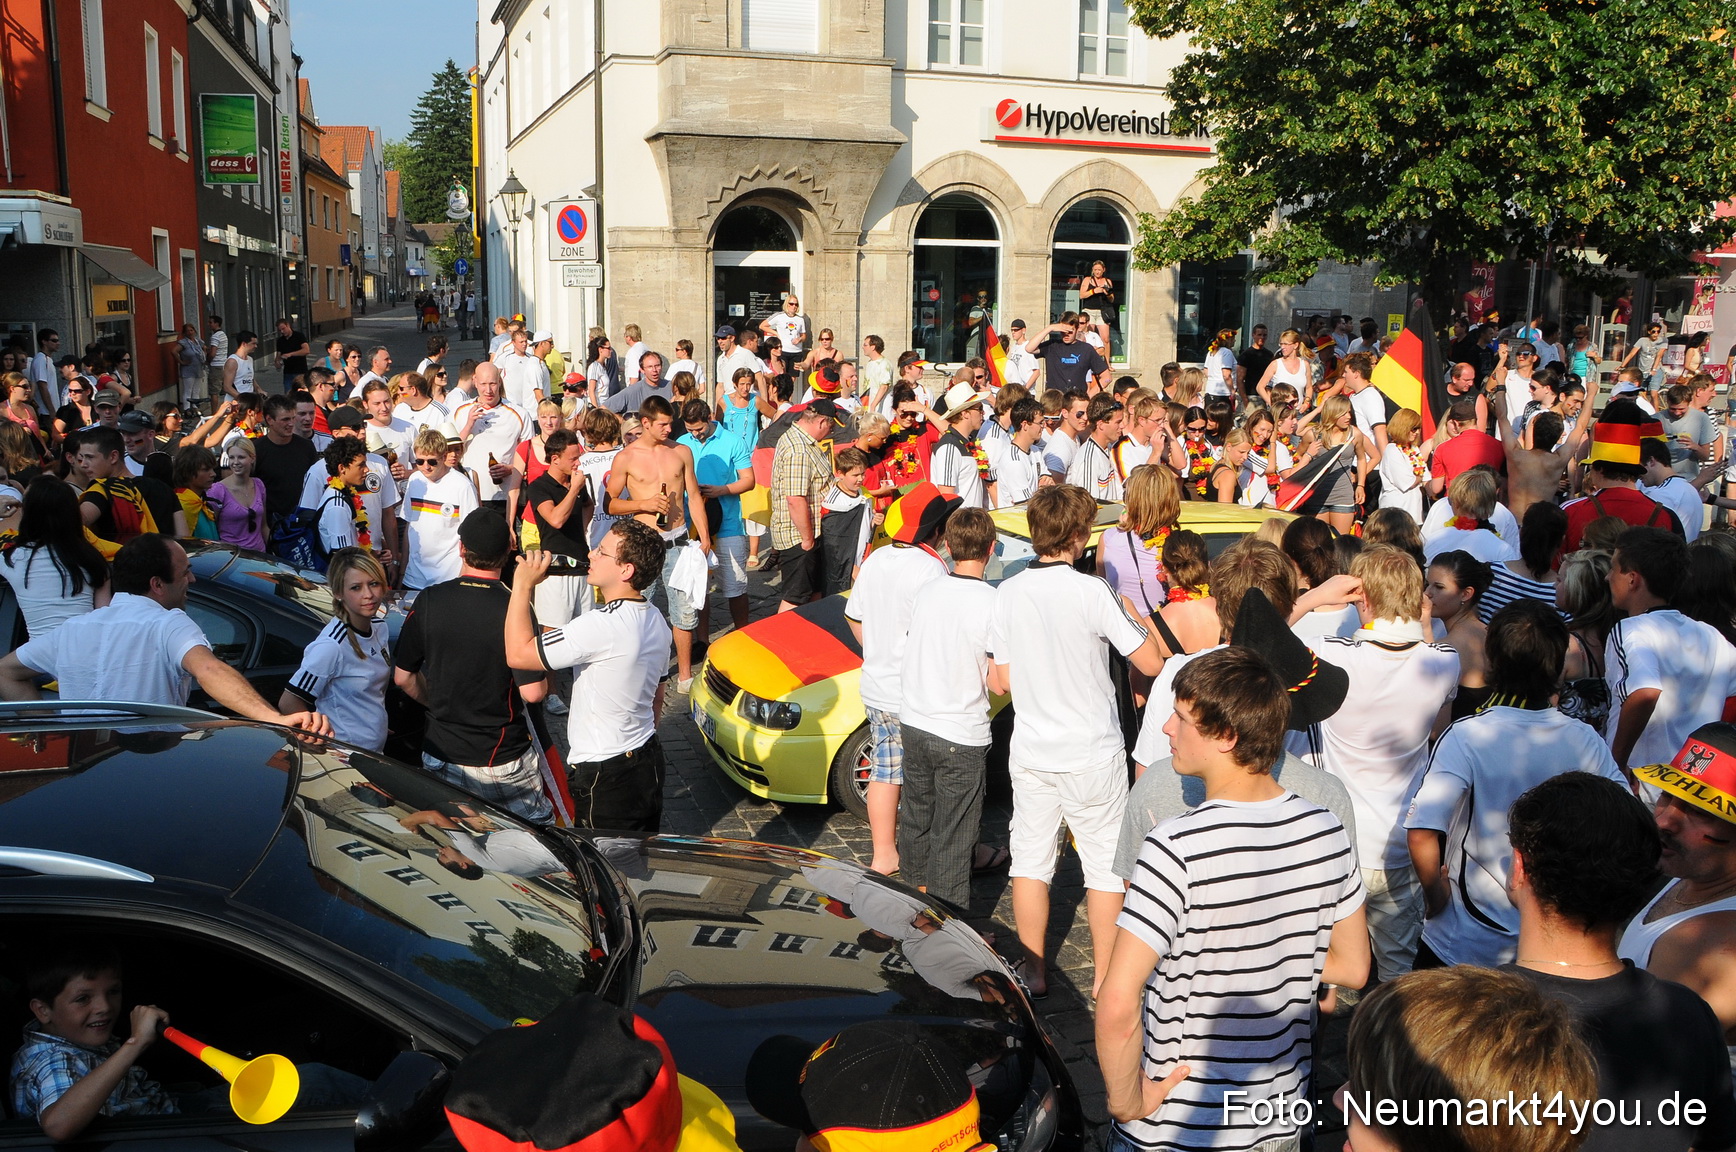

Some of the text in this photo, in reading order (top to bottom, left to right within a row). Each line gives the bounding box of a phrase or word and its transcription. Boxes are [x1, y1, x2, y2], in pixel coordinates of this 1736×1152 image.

[280, 115, 292, 193] MERZ Reisen
[210, 159, 239, 167] dess
[561, 246, 584, 257] ZONE
[1688, 320, 1713, 331] -70%
